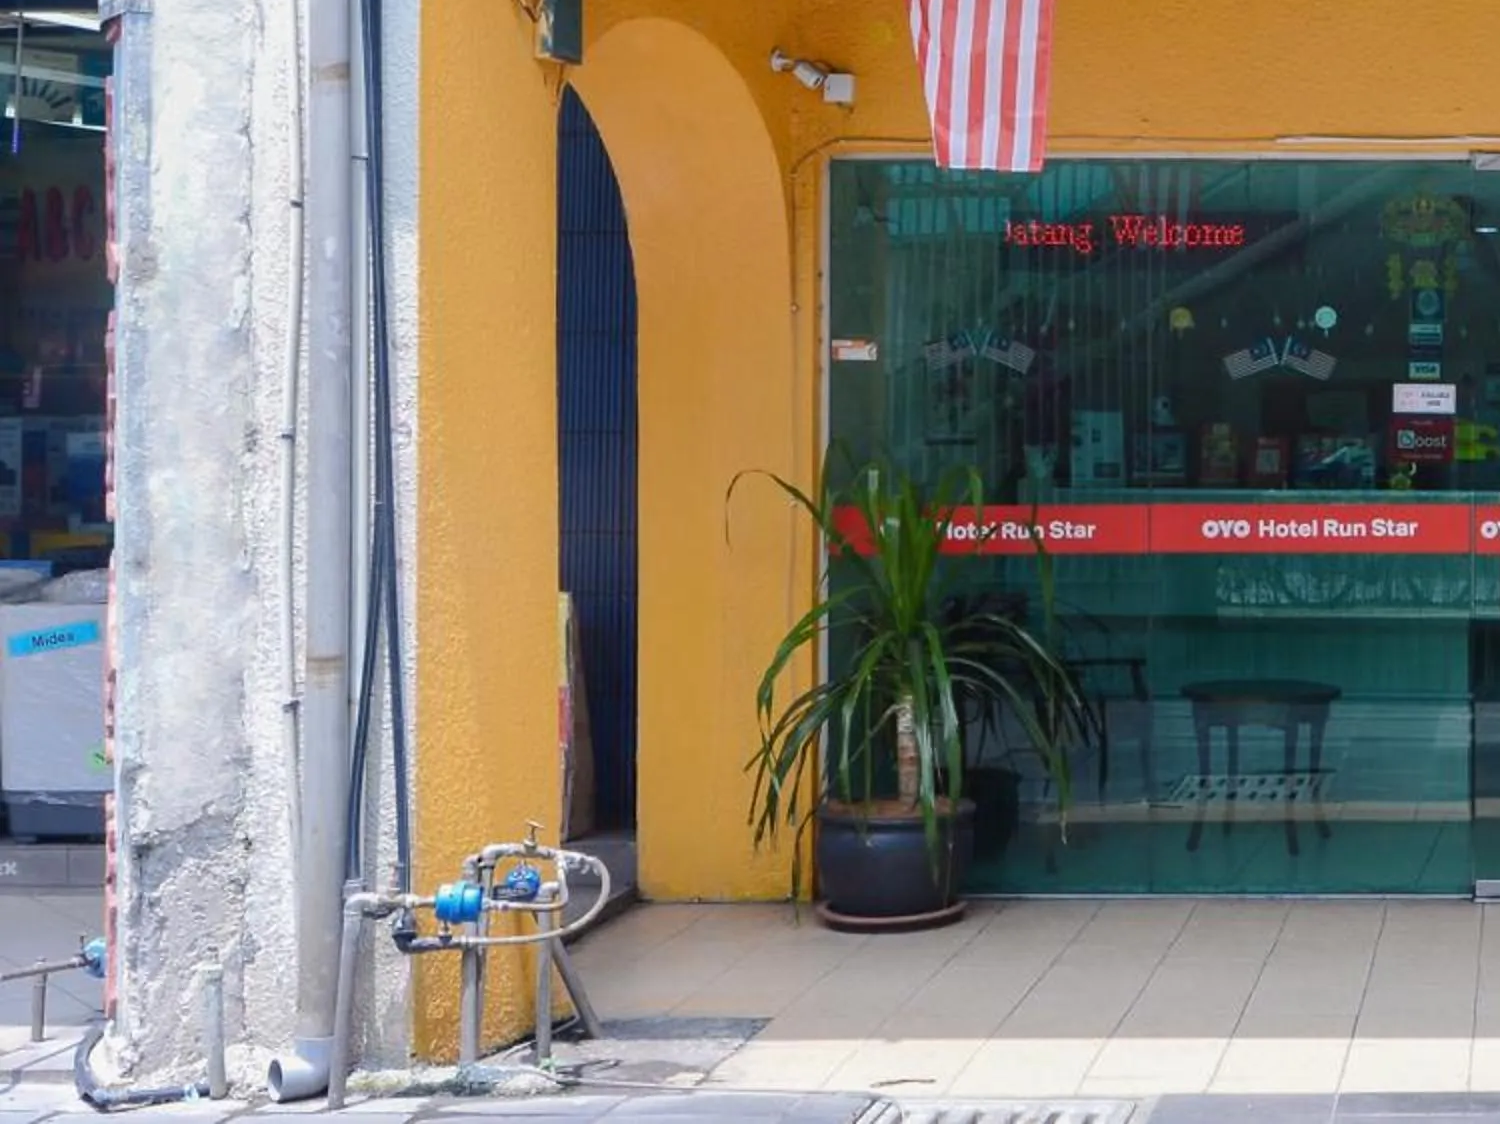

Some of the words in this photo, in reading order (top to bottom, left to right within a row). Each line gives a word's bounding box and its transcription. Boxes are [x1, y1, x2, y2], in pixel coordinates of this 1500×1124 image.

[1109, 215, 1244, 246] Welcome
[1049, 521, 1096, 539] Star
[1202, 519, 1251, 538] OYO
[1258, 519, 1318, 538] Hotel
[1323, 519, 1366, 537] Run
[1371, 518, 1418, 537] Star
